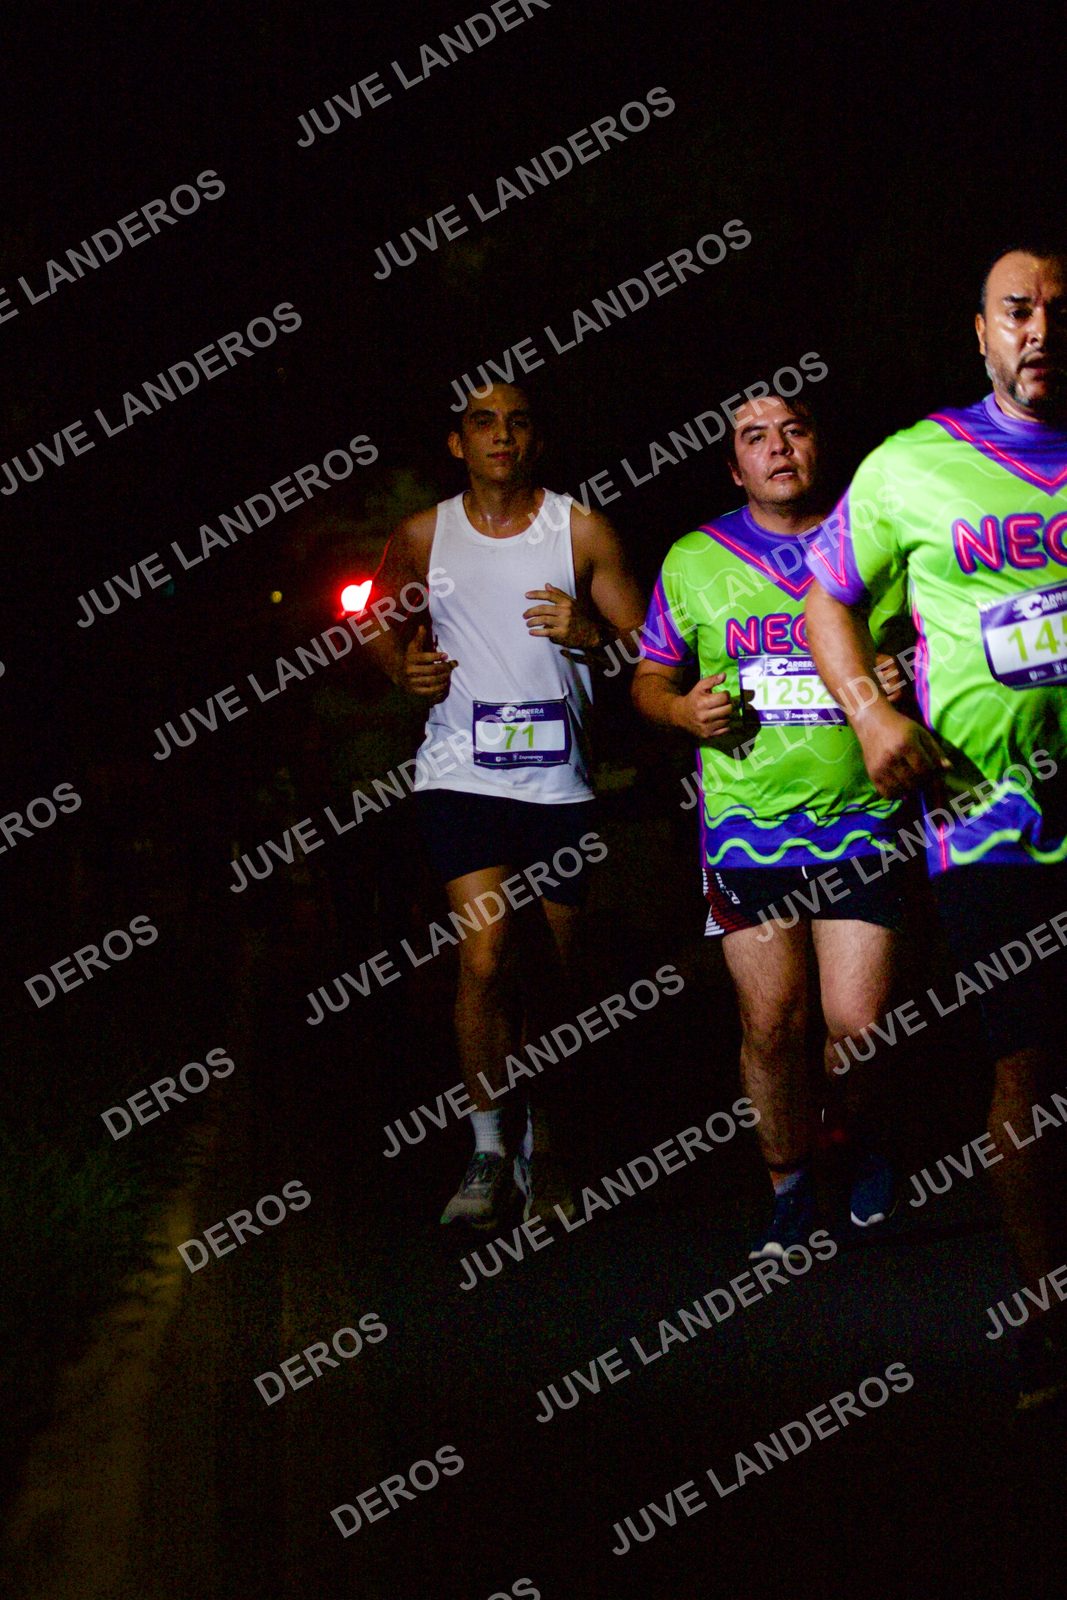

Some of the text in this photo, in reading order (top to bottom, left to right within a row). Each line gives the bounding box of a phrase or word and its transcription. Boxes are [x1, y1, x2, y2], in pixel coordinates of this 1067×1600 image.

[770, 658, 816, 675] CARRER
[757, 678, 834, 704] 1252
[501, 706, 544, 722] CARRERA
[503, 725, 534, 750] 71
